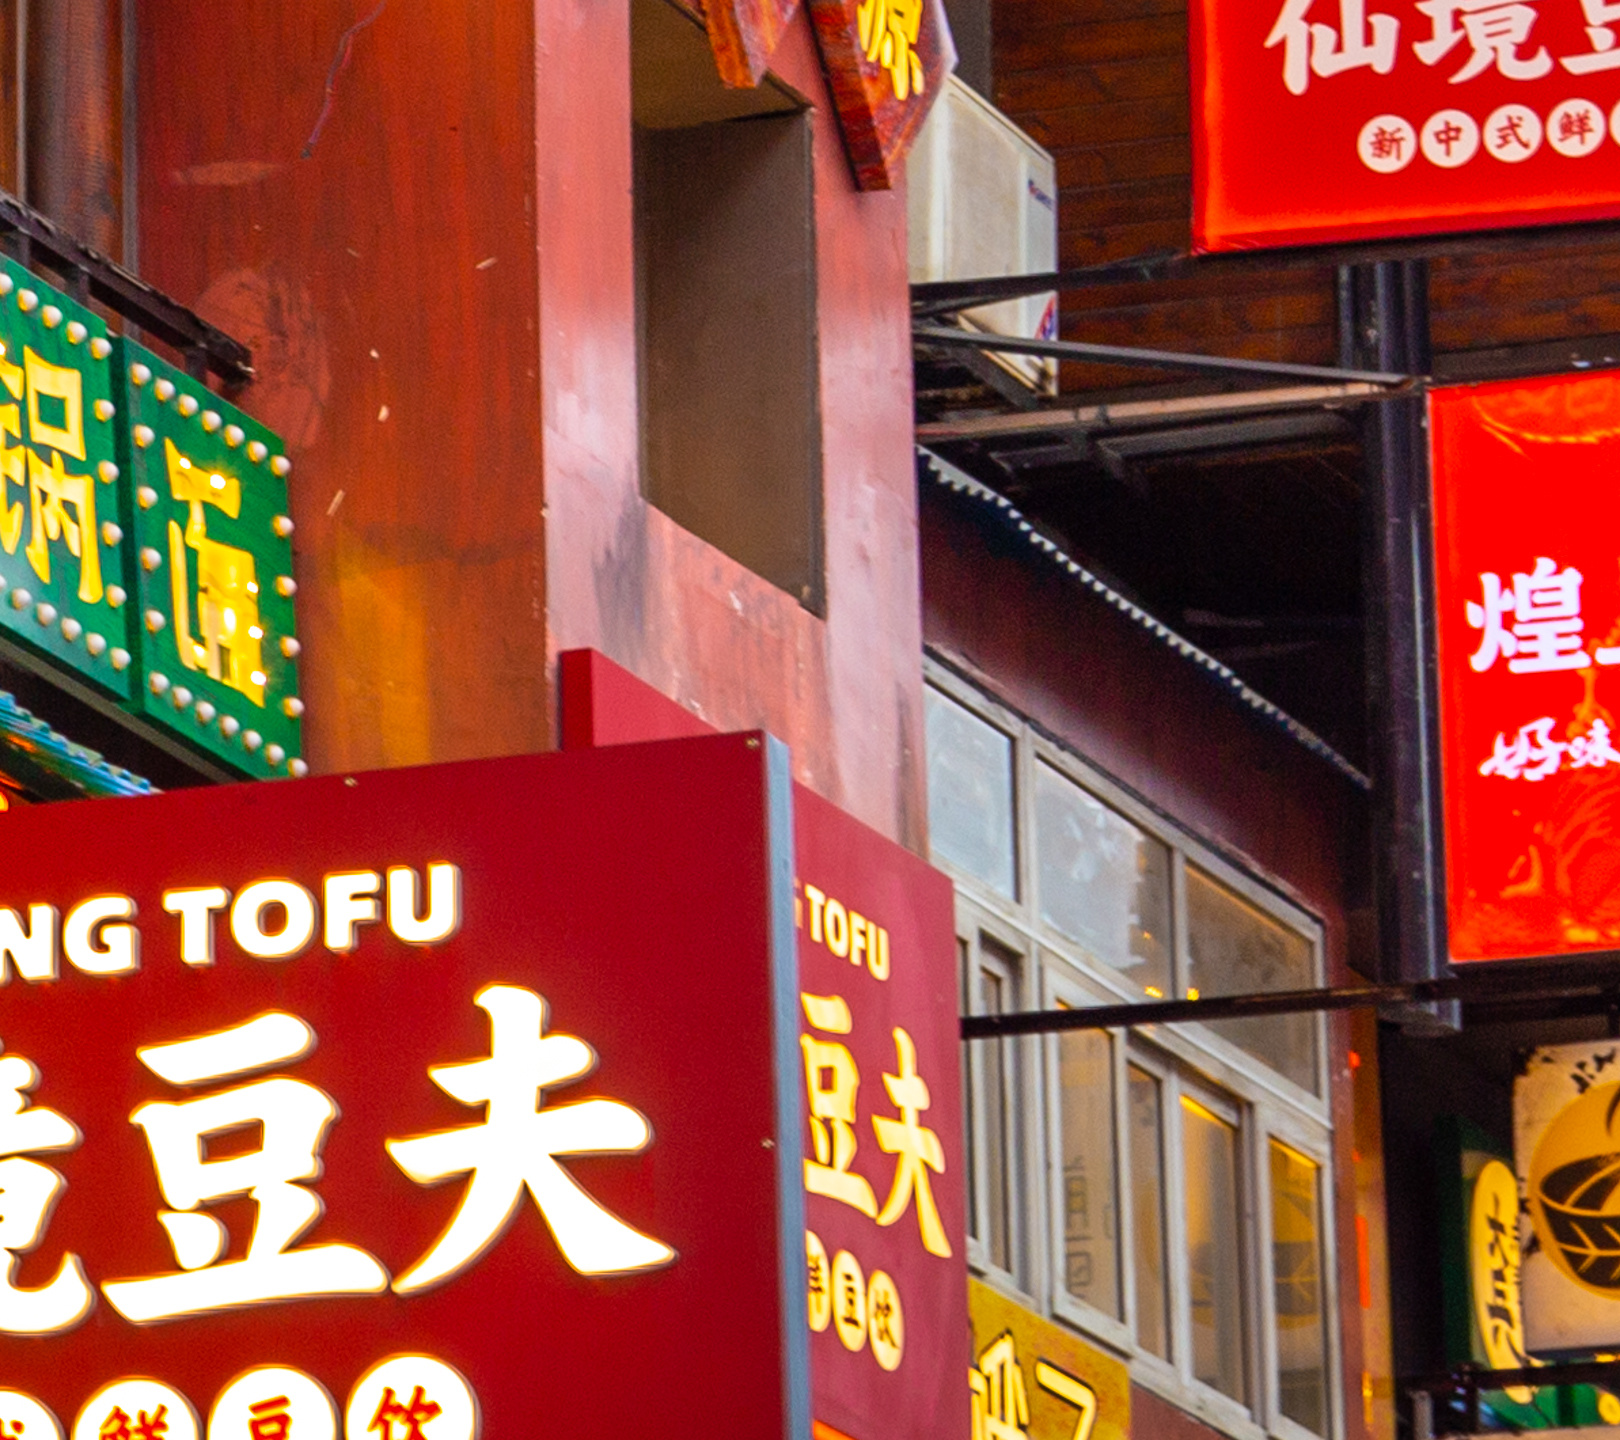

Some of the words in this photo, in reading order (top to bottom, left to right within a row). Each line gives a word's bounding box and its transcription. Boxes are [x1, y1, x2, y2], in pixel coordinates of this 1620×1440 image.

[161, 862, 462, 968] TOFU
[804, 882, 892, 984] TOFU
[799, 988, 953, 1260] 豆夫
